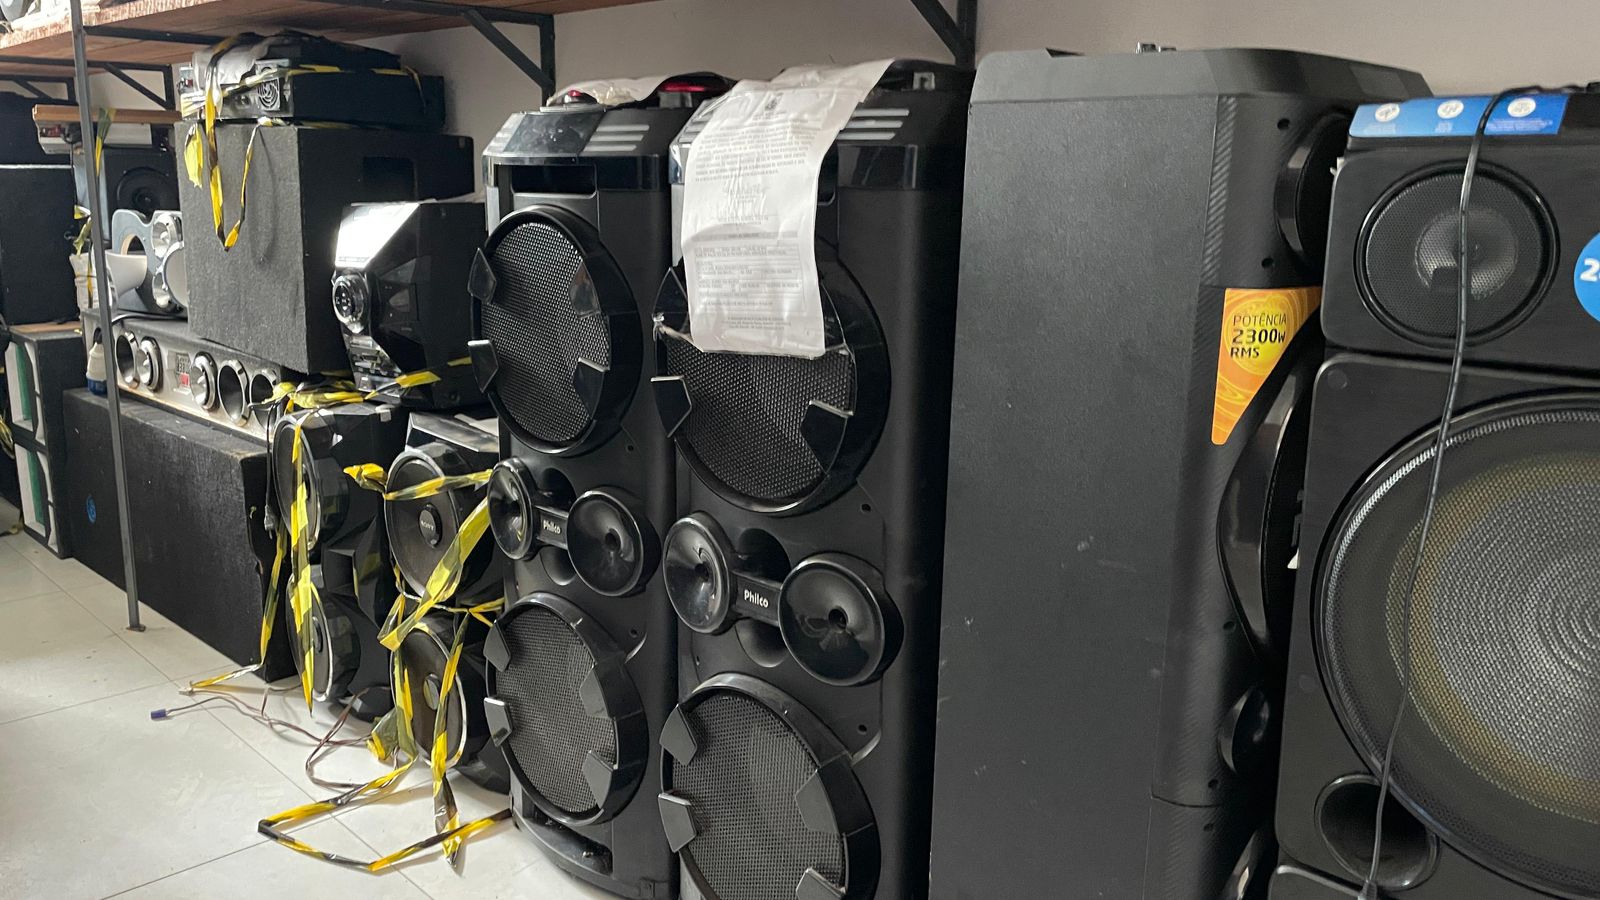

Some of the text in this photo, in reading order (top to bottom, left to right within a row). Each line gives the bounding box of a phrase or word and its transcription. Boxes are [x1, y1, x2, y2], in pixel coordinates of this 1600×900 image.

[1580, 257, 1600, 282] 2
[1233, 312, 1287, 327] POTÊNCIA
[1230, 347, 1260, 359] RMS
[543, 519, 561, 535] Philco
[744, 589, 769, 608] Philco
